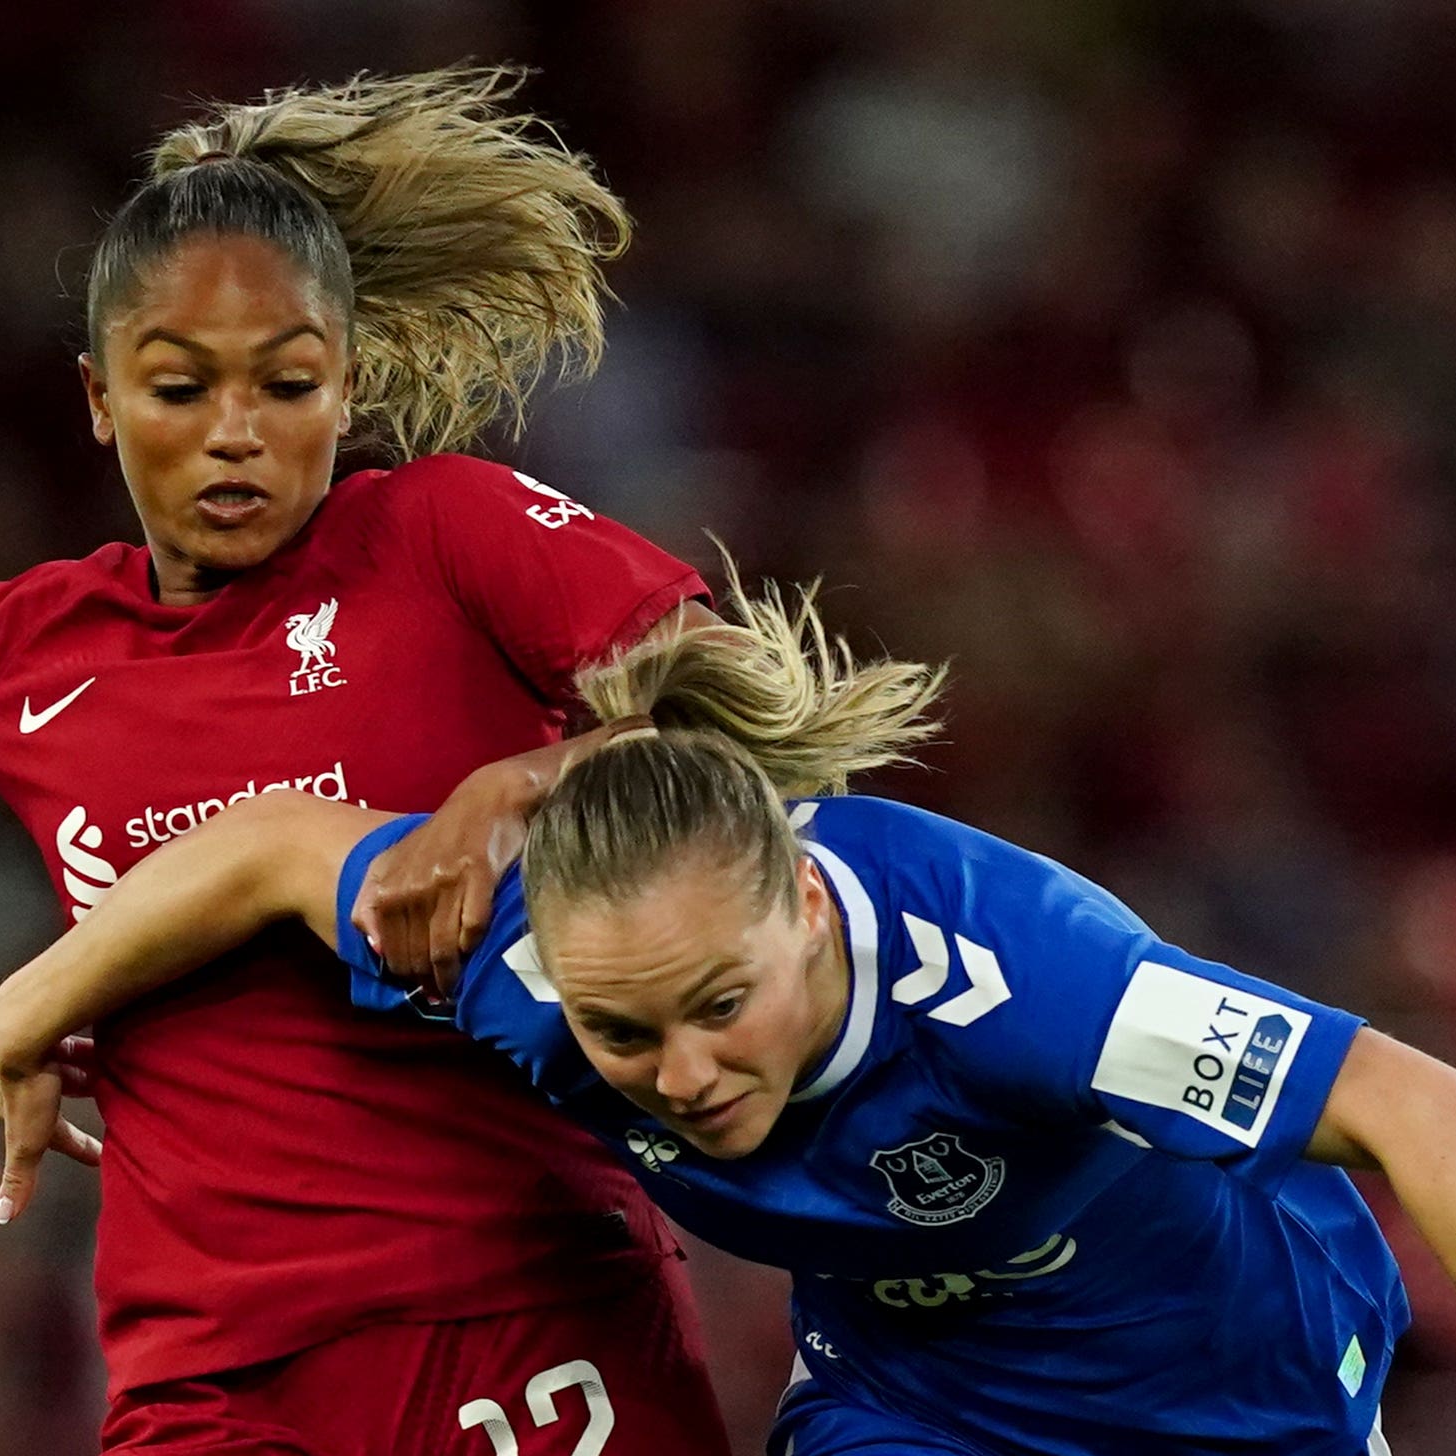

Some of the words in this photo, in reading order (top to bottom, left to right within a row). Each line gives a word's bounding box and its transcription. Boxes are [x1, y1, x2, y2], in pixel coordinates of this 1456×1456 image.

[1181, 996, 1249, 1112] BOXT
[1231, 1031, 1284, 1110] LIFE
[915, 1172, 977, 1205] Everton
